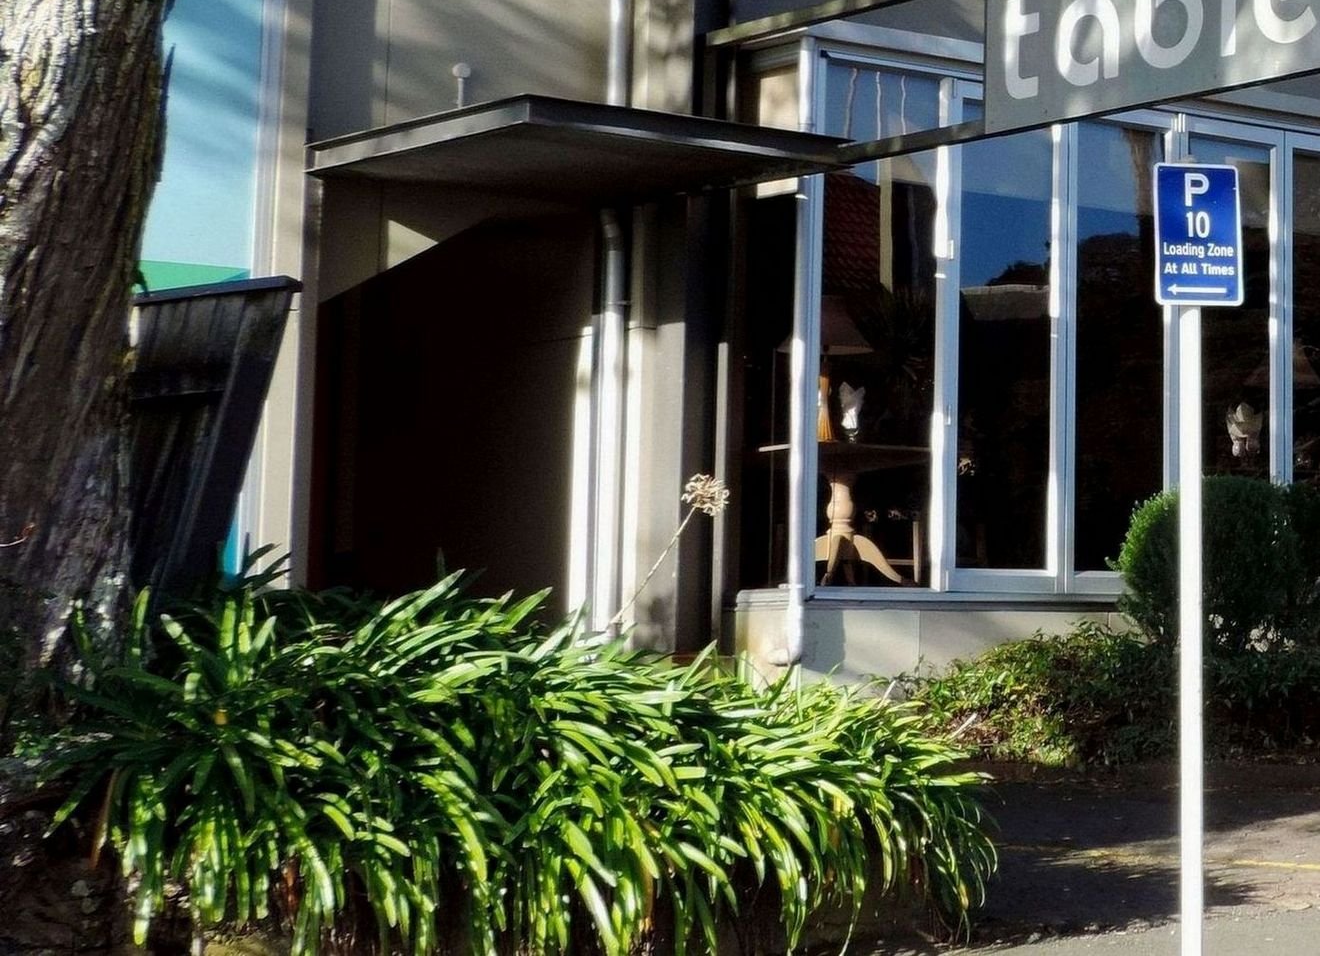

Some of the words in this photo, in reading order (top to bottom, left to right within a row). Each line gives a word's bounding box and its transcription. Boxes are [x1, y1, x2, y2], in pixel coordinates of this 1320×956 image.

[1184, 172, 1210, 207] P
[1186, 210, 1210, 238] 10
[1163, 242, 1205, 258] Loading
[1207, 243, 1234, 257] Zone
[1164, 262, 1178, 274] At
[1181, 262, 1198, 275] All
[1201, 263, 1235, 276] Times
